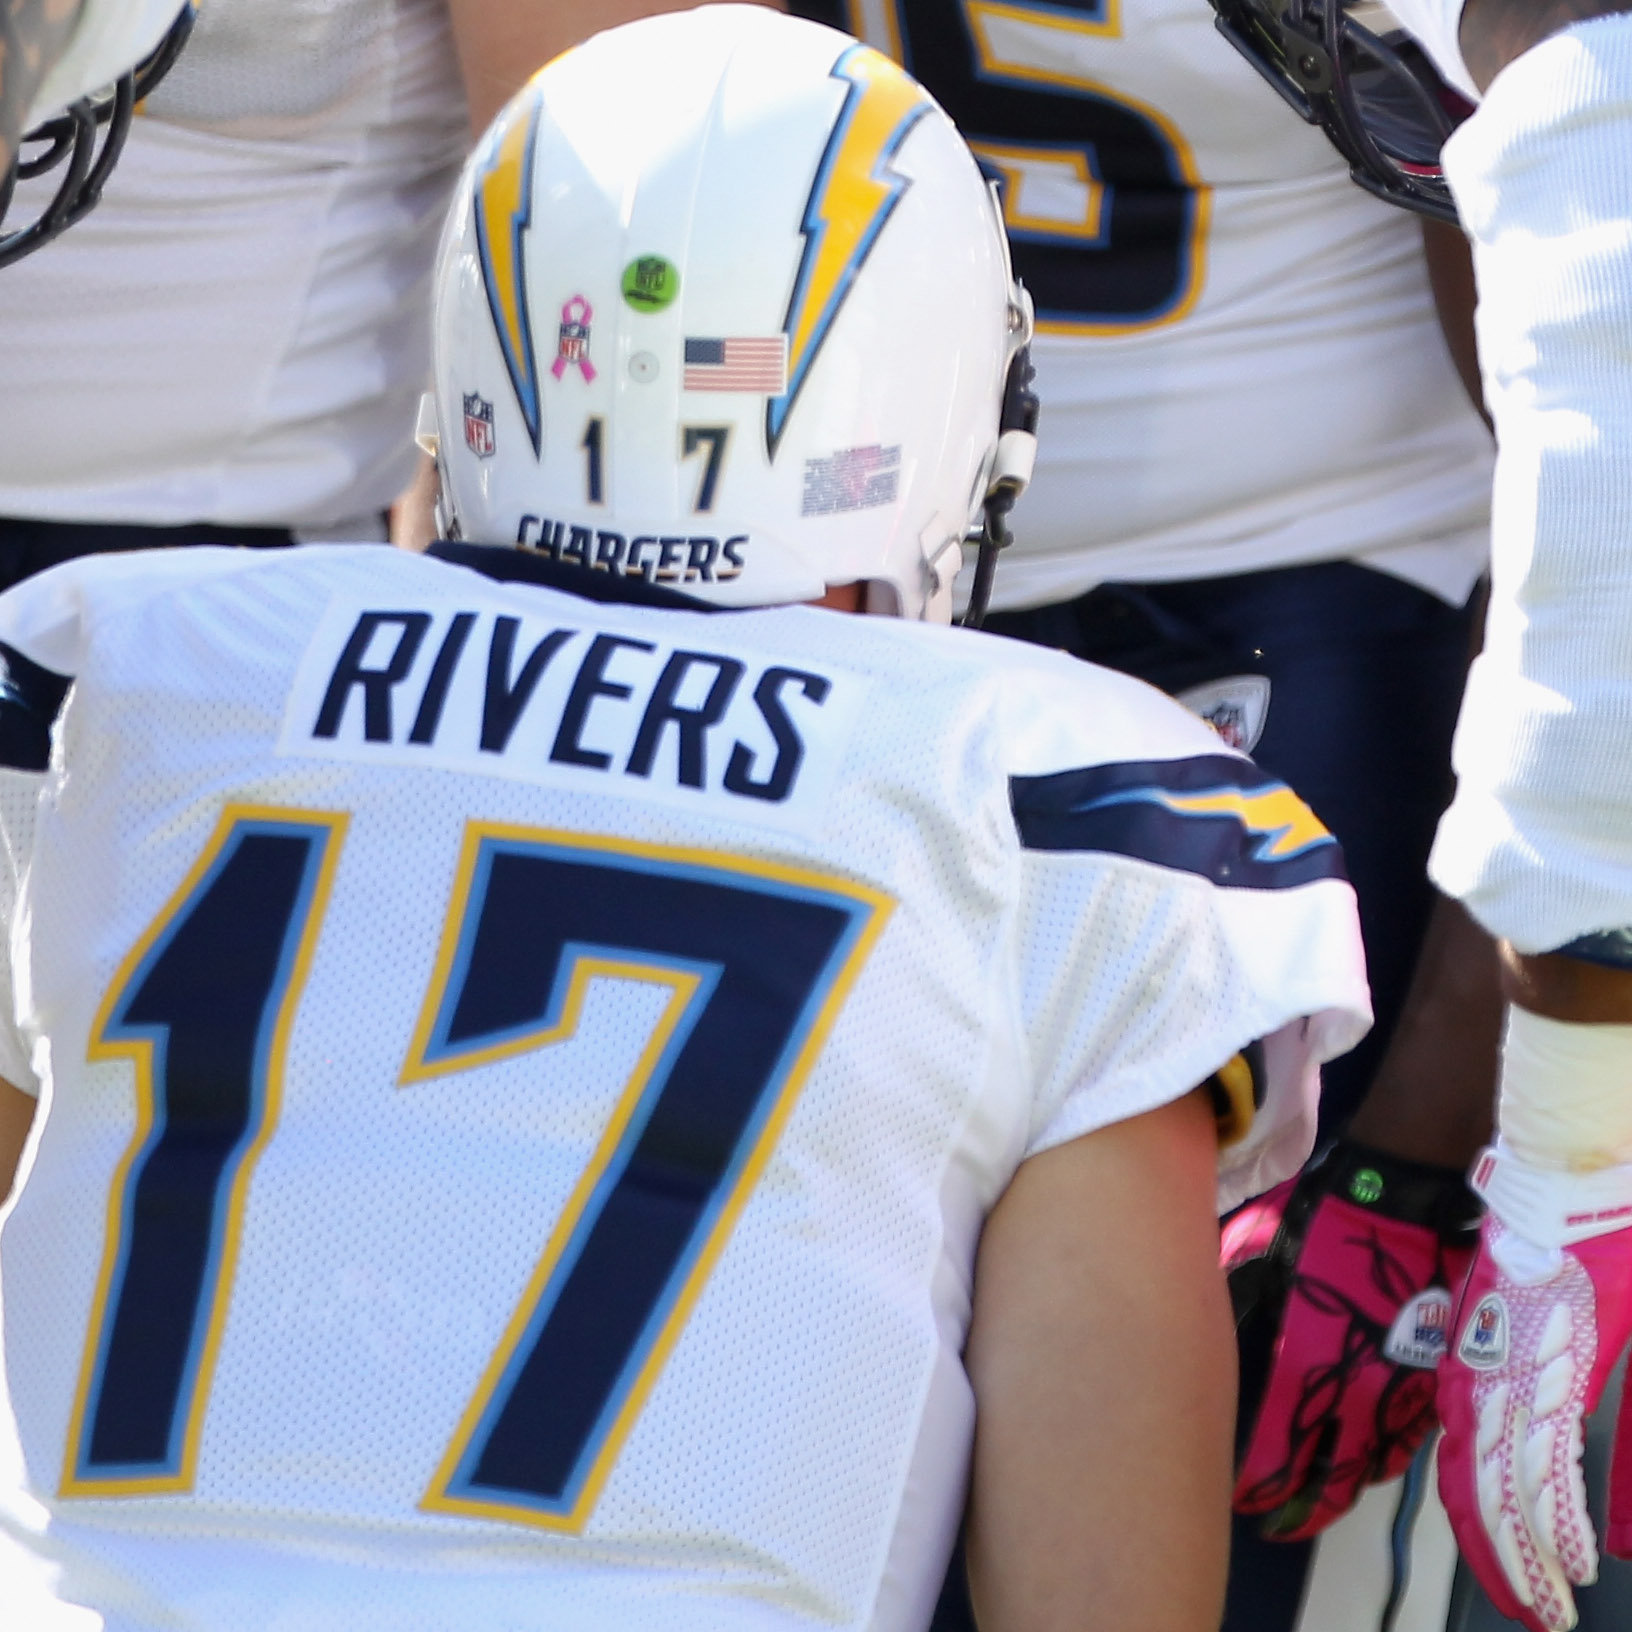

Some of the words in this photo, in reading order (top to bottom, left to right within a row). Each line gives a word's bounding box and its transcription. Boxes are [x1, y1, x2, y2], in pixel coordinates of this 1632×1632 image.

[516, 514, 749, 585] CHARGERS
[312, 610, 831, 804] RIVERS
[57, 802, 899, 1536] 17
